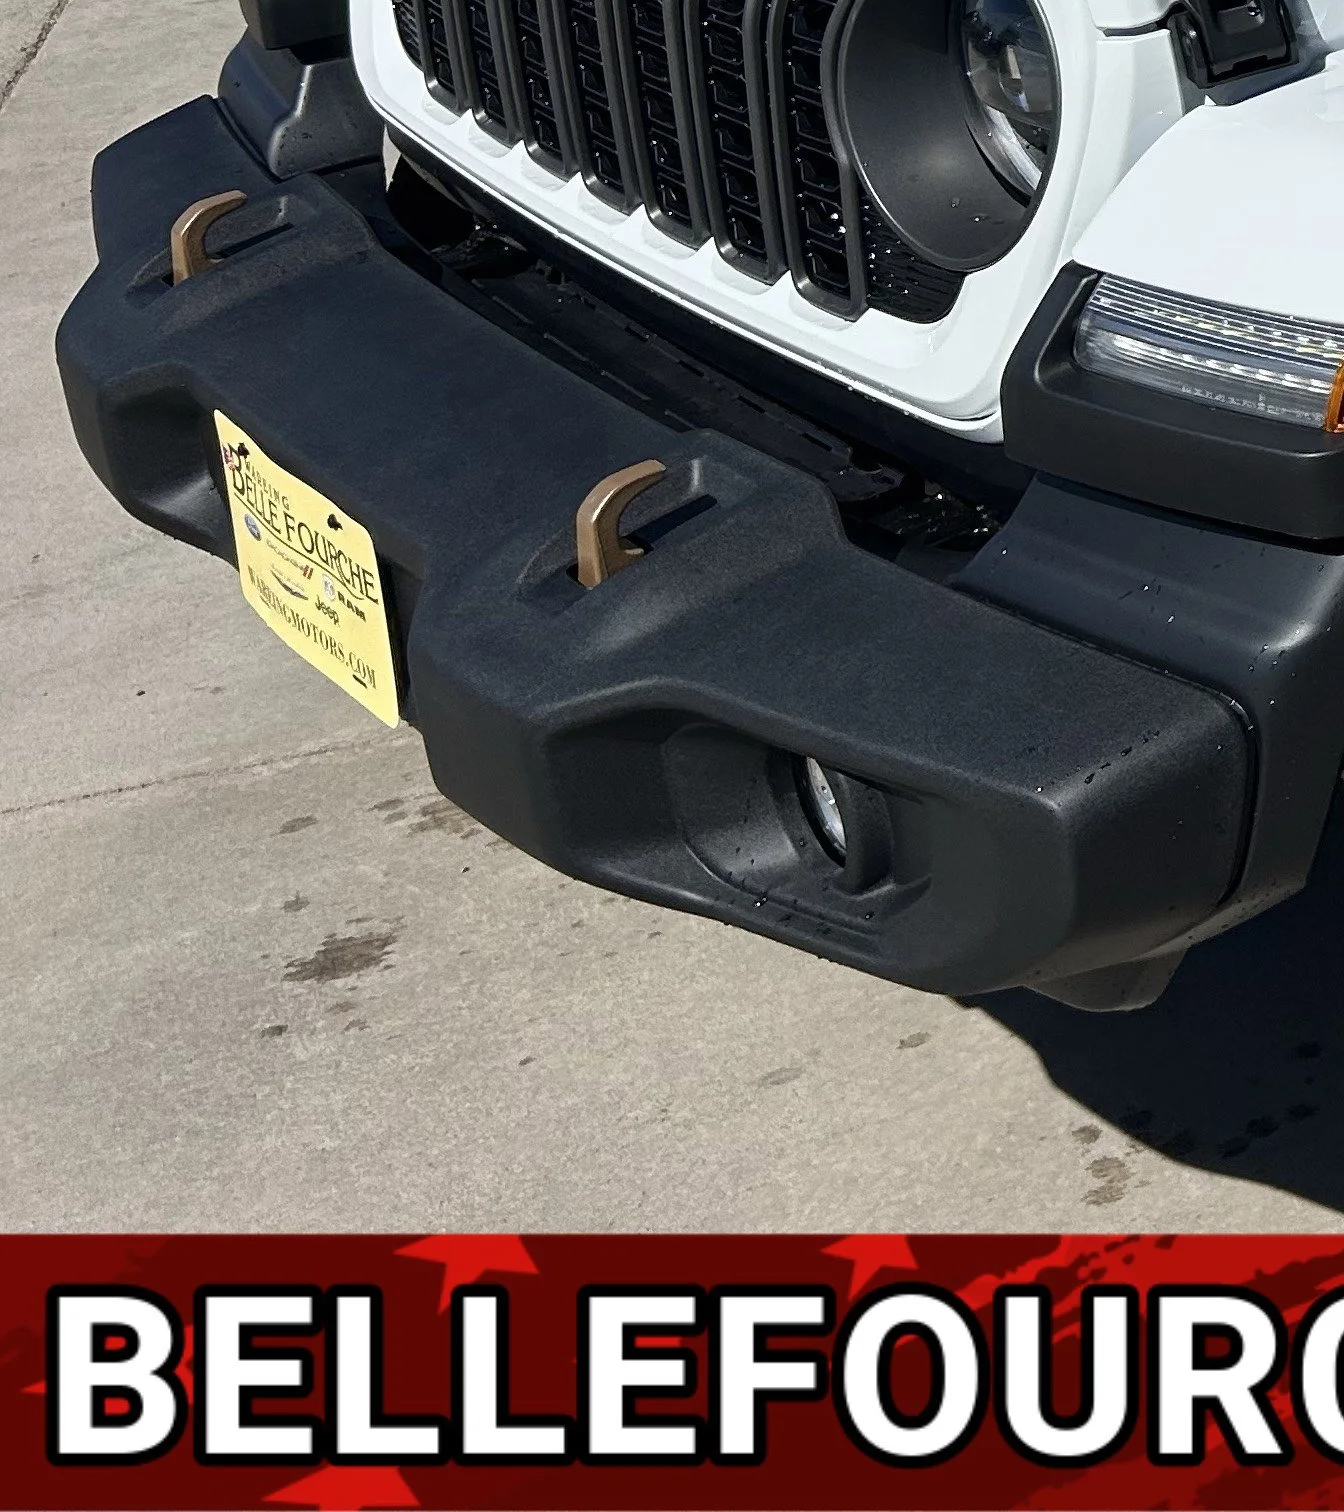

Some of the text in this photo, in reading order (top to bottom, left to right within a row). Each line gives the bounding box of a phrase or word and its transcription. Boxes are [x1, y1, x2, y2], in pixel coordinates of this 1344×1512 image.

[228, 443, 379, 605] BELLE FOURCHE
[314, 594, 340, 626] Jeep
